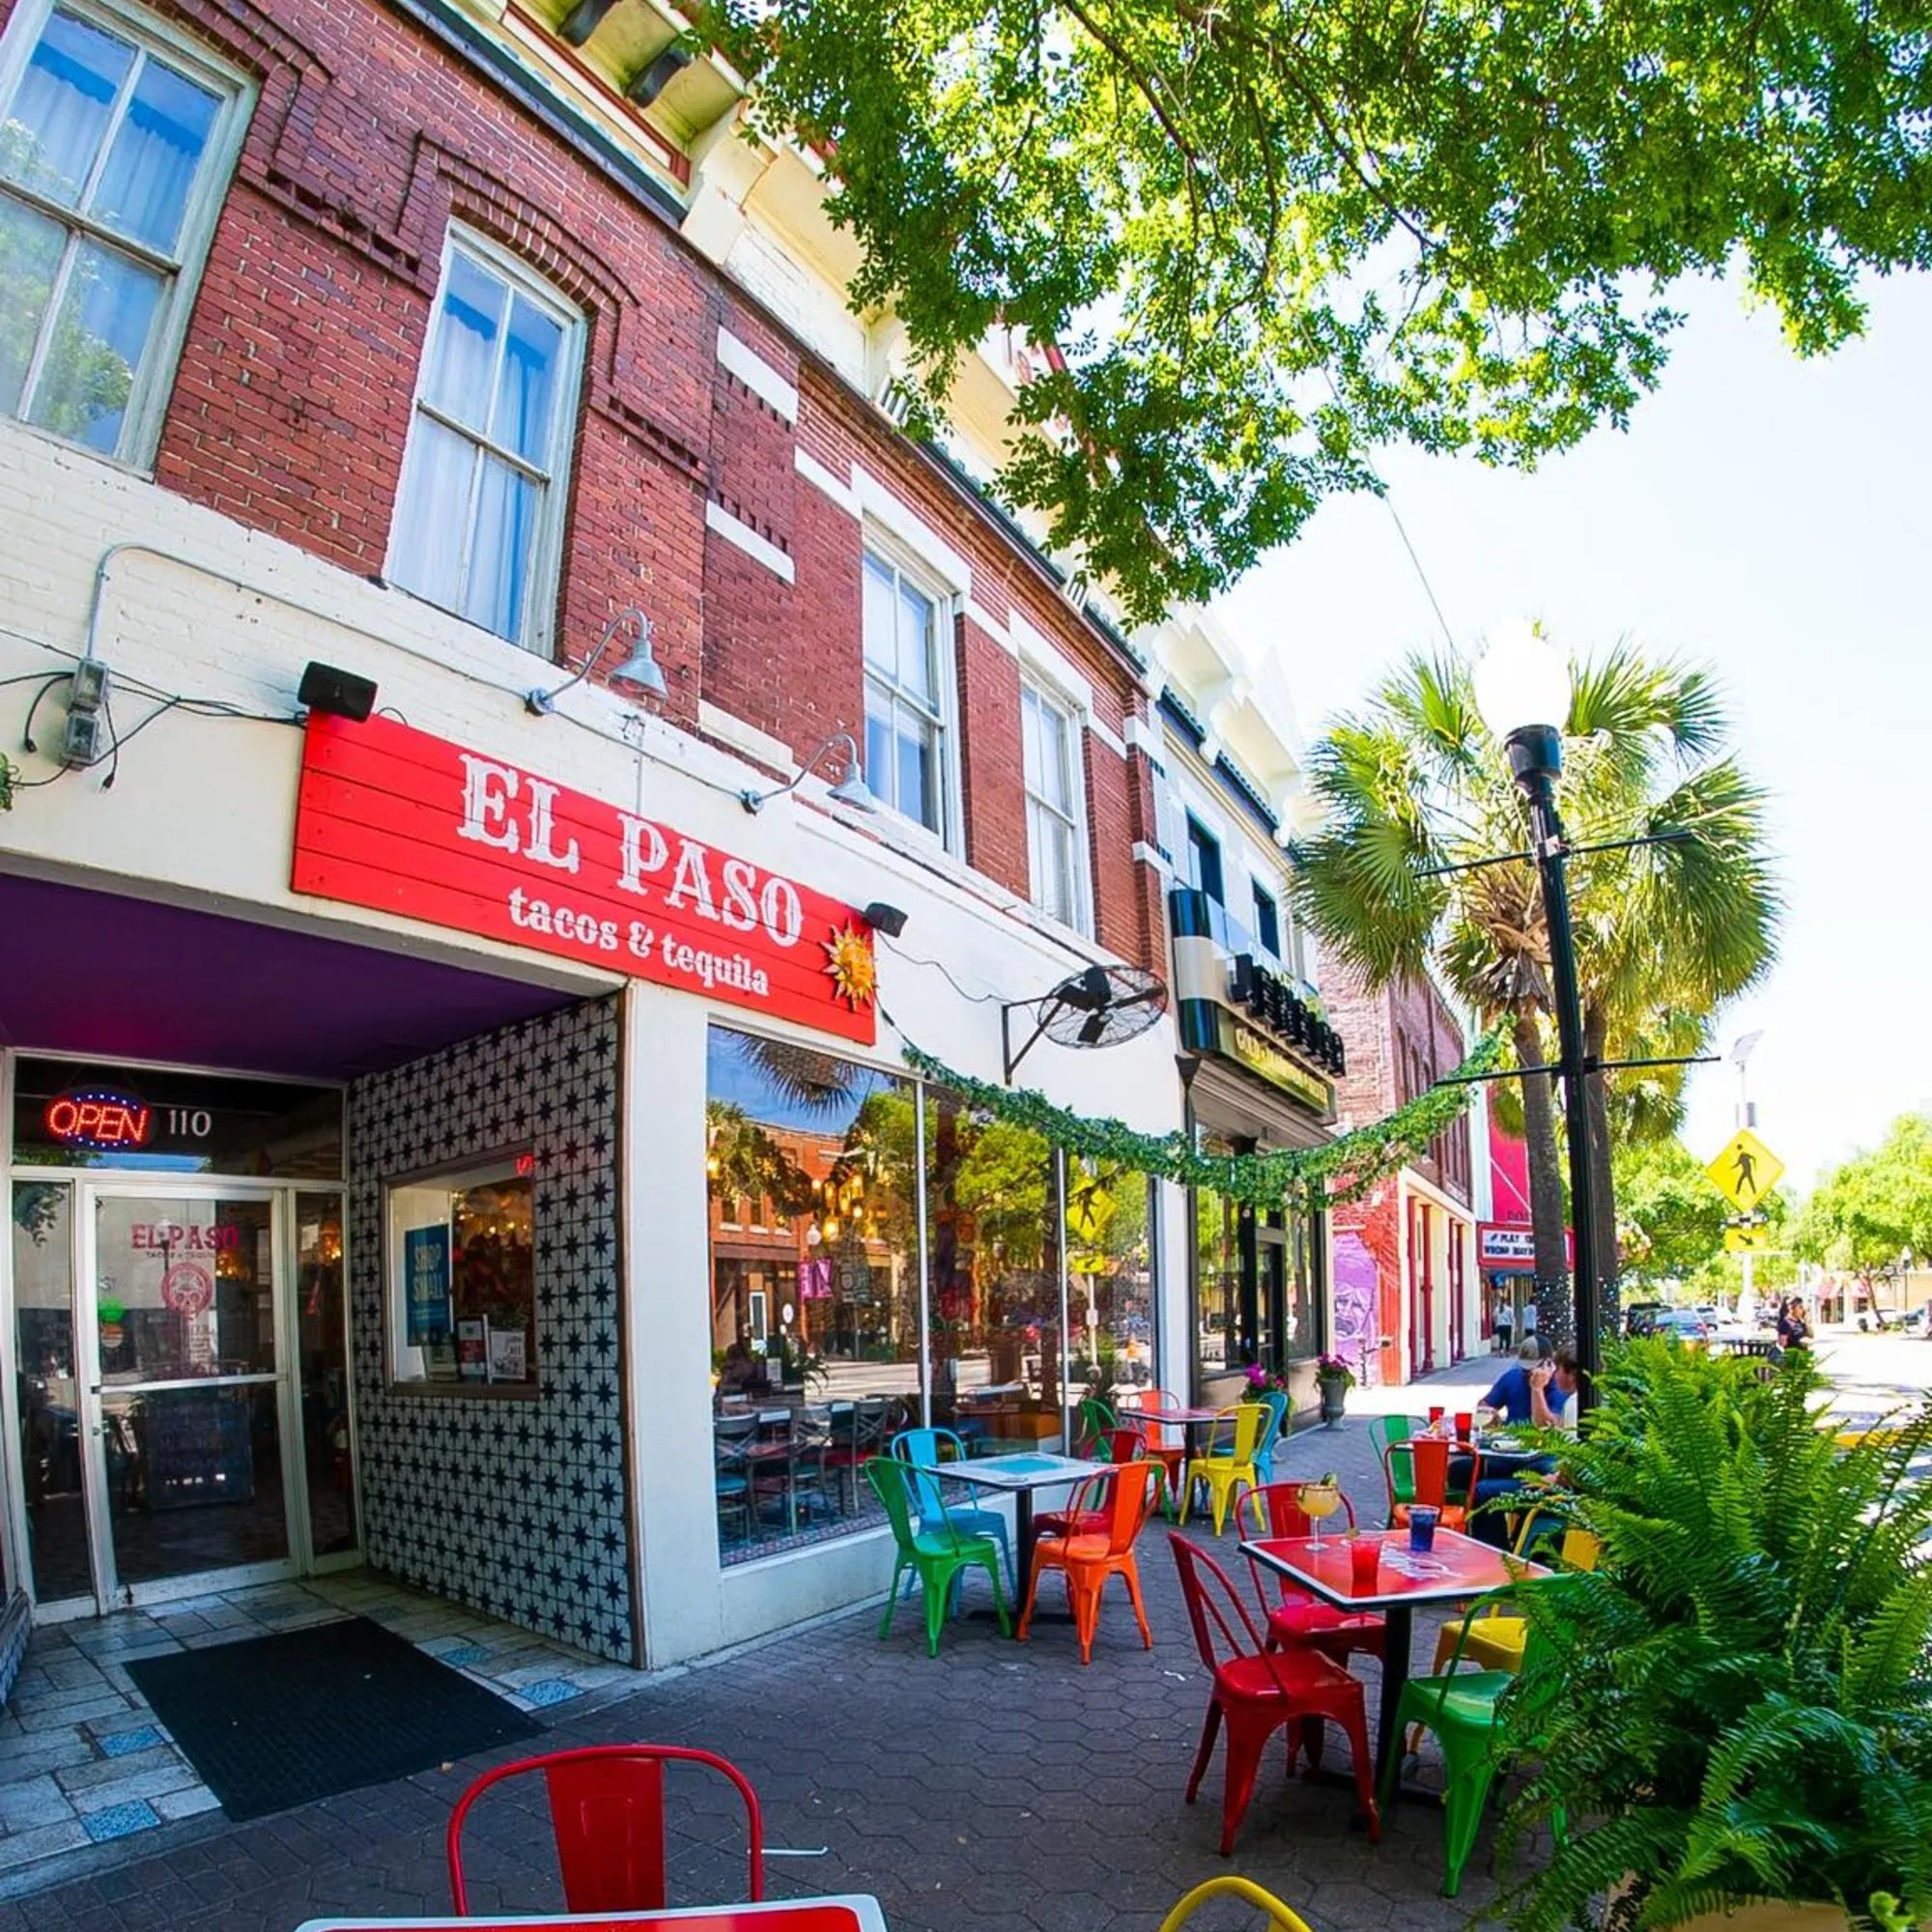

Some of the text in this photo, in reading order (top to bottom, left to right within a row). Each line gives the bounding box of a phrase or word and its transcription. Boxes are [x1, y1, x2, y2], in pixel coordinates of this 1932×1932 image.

[457, 753, 804, 948] EL PASO
[508, 887, 769, 997] tacos & tequila
[50, 1101, 147, 1142] OPEN
[170, 1110, 212, 1136] 110
[131, 1224, 240, 1250] EL PASO
